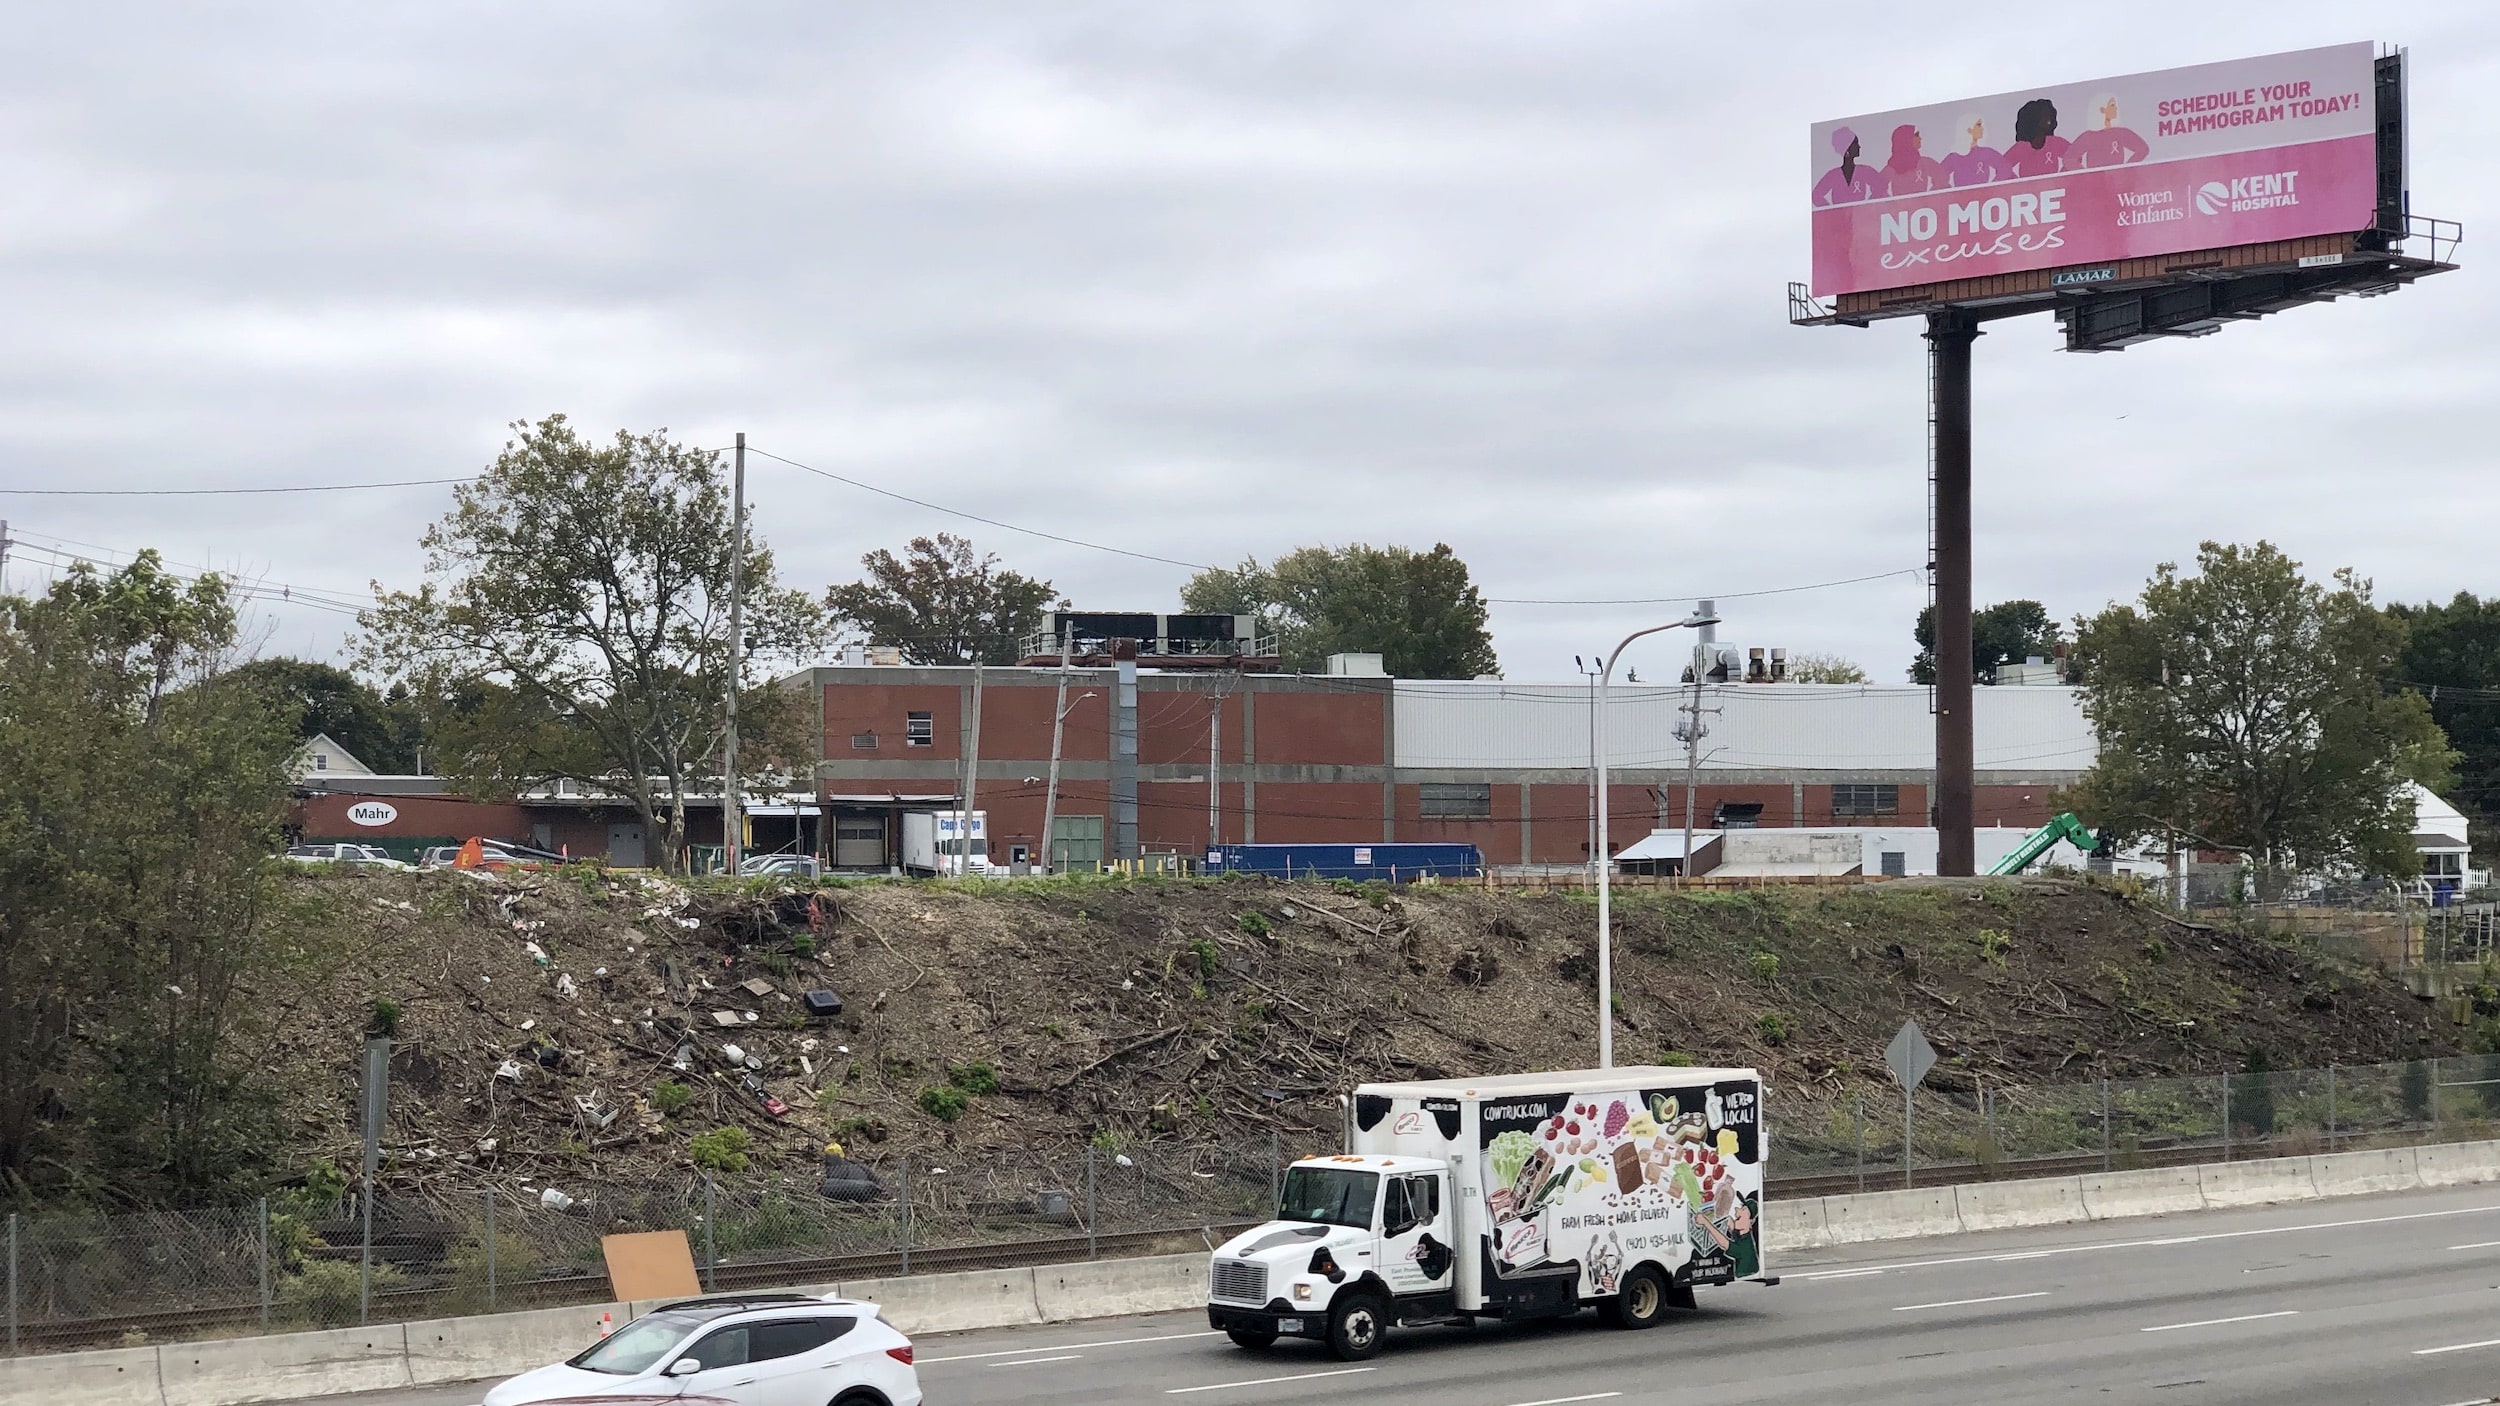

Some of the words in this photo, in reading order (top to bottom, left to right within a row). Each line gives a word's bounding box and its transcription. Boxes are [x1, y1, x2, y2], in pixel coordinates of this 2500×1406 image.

[2158, 89, 2256, 117] SCHEDULE
[2260, 80, 2311, 103] YOUR
[2158, 104, 2284, 137] MAMMOGRAM
[2288, 93, 2360, 119] TODAY!
[2231, 170, 2299, 199] KENT
[2117, 190, 2173, 208] Women
[2231, 194, 2300, 212] HOSPITAL
[1880, 207, 1938, 246] NO
[1948, 188, 2067, 236] MORE
[1880, 225, 2066, 270] excuses
[2057, 269, 2111, 284] LAMAR
[355, 807, 390, 819] Mahr
[1484, 1103, 1549, 1121] COWTRUCK.COM
[1724, 1107, 1754, 1125] LOCAL!
[1561, 1216, 1581, 1229] FARM
[1584, 1213, 1605, 1227] FRESH
[1616, 1210, 1638, 1224] HOME
[1640, 1207, 1670, 1221] DELIVERY
[1625, 1236, 1647, 1251] (401)
[1649, 1233, 1685, 1248] 435-MILK
